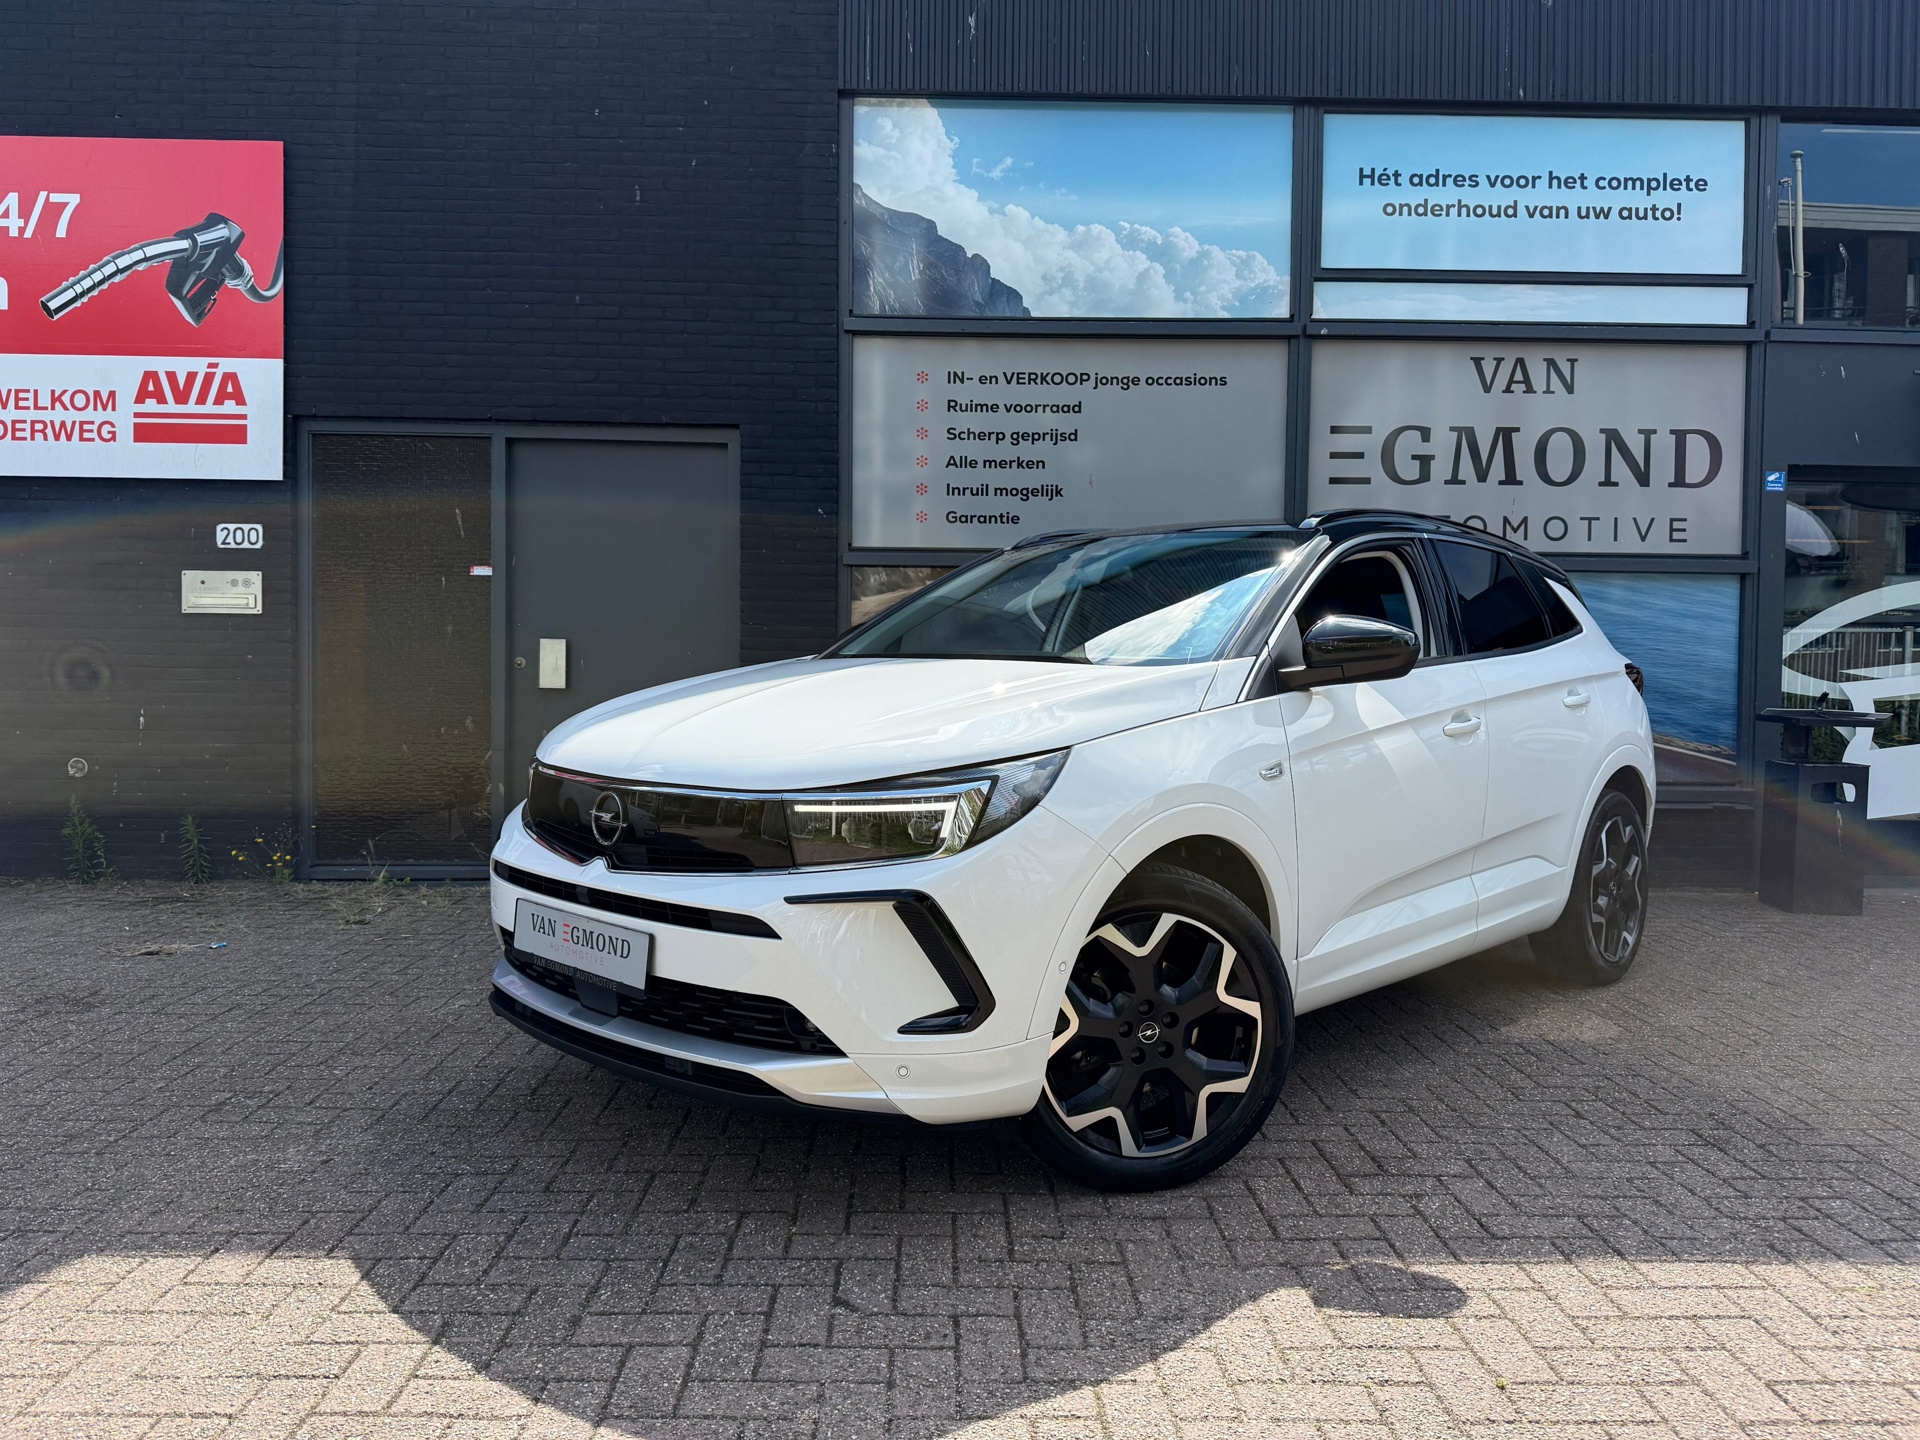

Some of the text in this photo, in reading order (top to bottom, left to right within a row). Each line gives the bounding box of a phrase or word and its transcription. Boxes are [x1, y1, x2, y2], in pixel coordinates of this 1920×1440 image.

[1358, 167, 1709, 196] Hét adres voor het complete
[1382, 198, 1683, 221] onderhoud van uw auto!
[947, 370, 1228, 391] IN- en VERKOOP jonge occasions
[1470, 356, 1579, 395] VAN
[947, 399, 1082, 415] Ruime voorraad
[946, 427, 1078, 447] Scherp geprijsd
[945, 455, 1046, 471] Alle merken
[1328, 424, 1724, 489] EGMOND
[946, 482, 1064, 502] Inruil mogelijk
[945, 510, 1021, 525] Garantie
[220, 526, 260, 546] 200
[531, 912, 631, 960] VAN EGMOND
[549, 942, 605, 966] AUTOMOTIVE
[533, 955, 546, 967] VAN
[575, 970, 618, 991] AUTOMOTIVE
